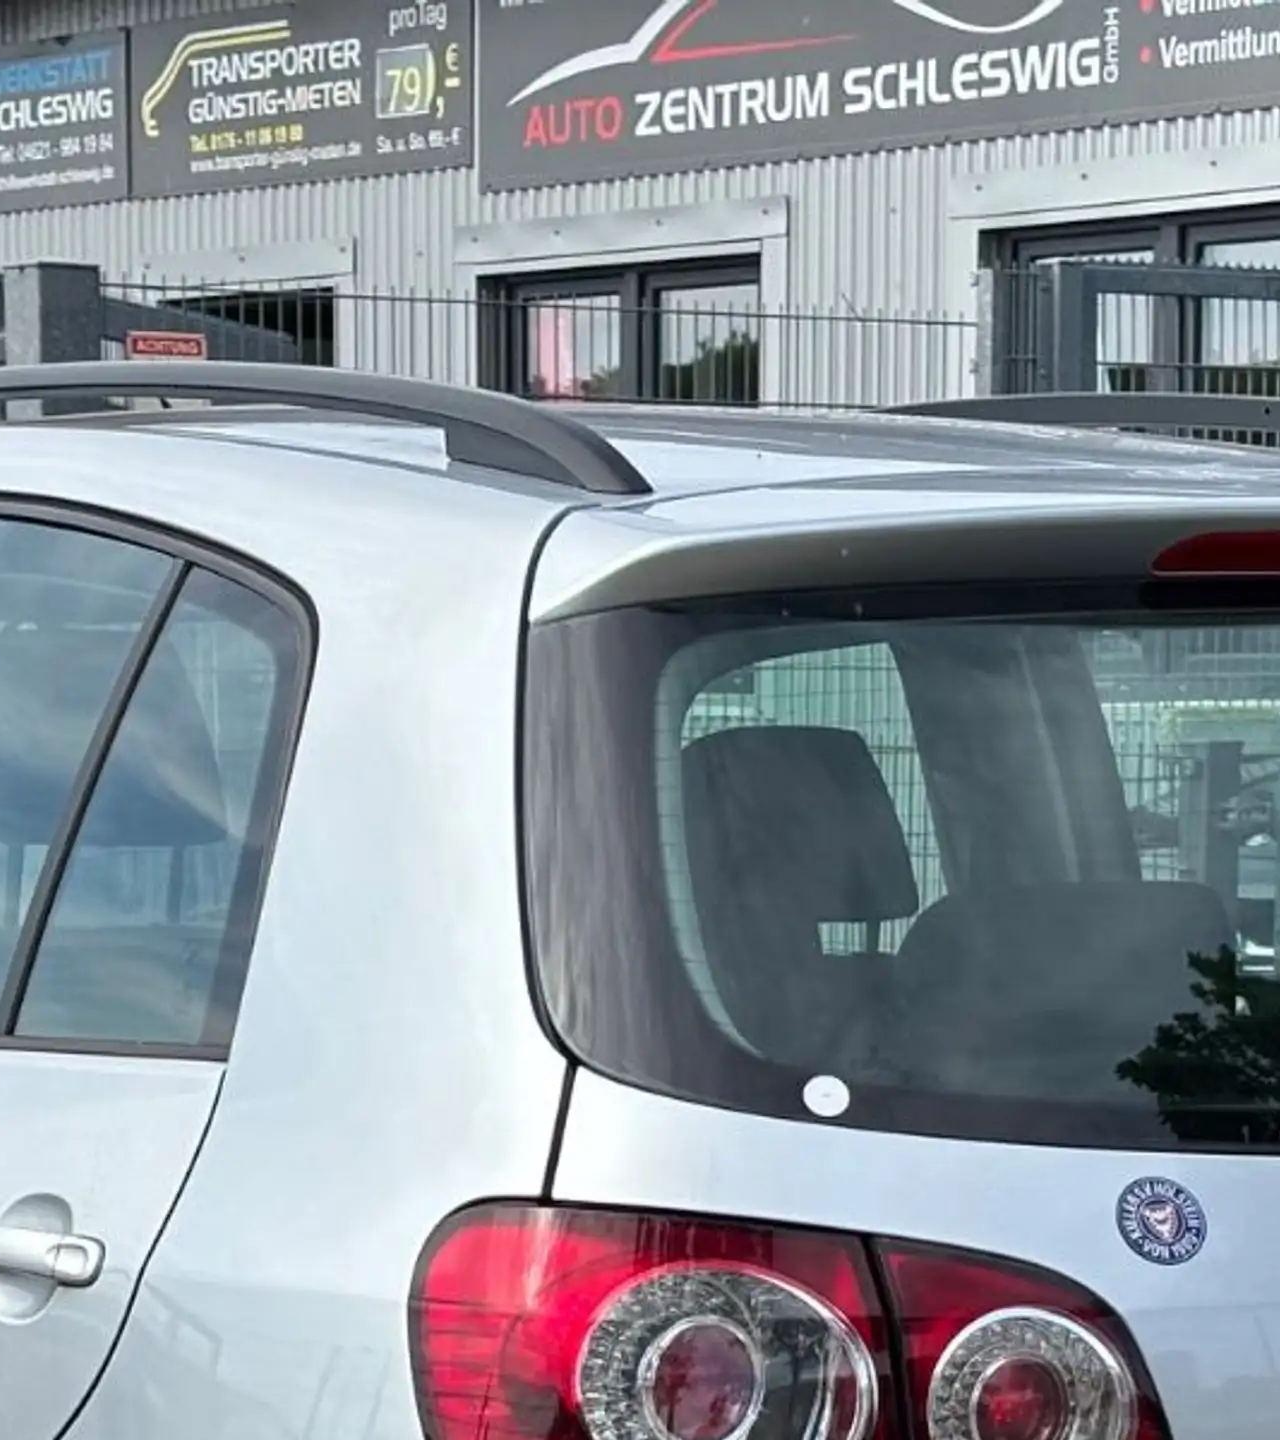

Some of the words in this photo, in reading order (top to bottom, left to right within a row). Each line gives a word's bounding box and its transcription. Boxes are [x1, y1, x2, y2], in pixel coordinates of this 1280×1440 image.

[188, 38, 361, 88] TRANSPORTER
[523, 97, 622, 149] AUTO
[634, 72, 829, 137] ZENTRUM
[843, 37, 1100, 115] SCHLESWIG
[1104, 6, 1119, 84] GmbH
[188, 78, 361, 124] GÜNSTIG-MIETEN
